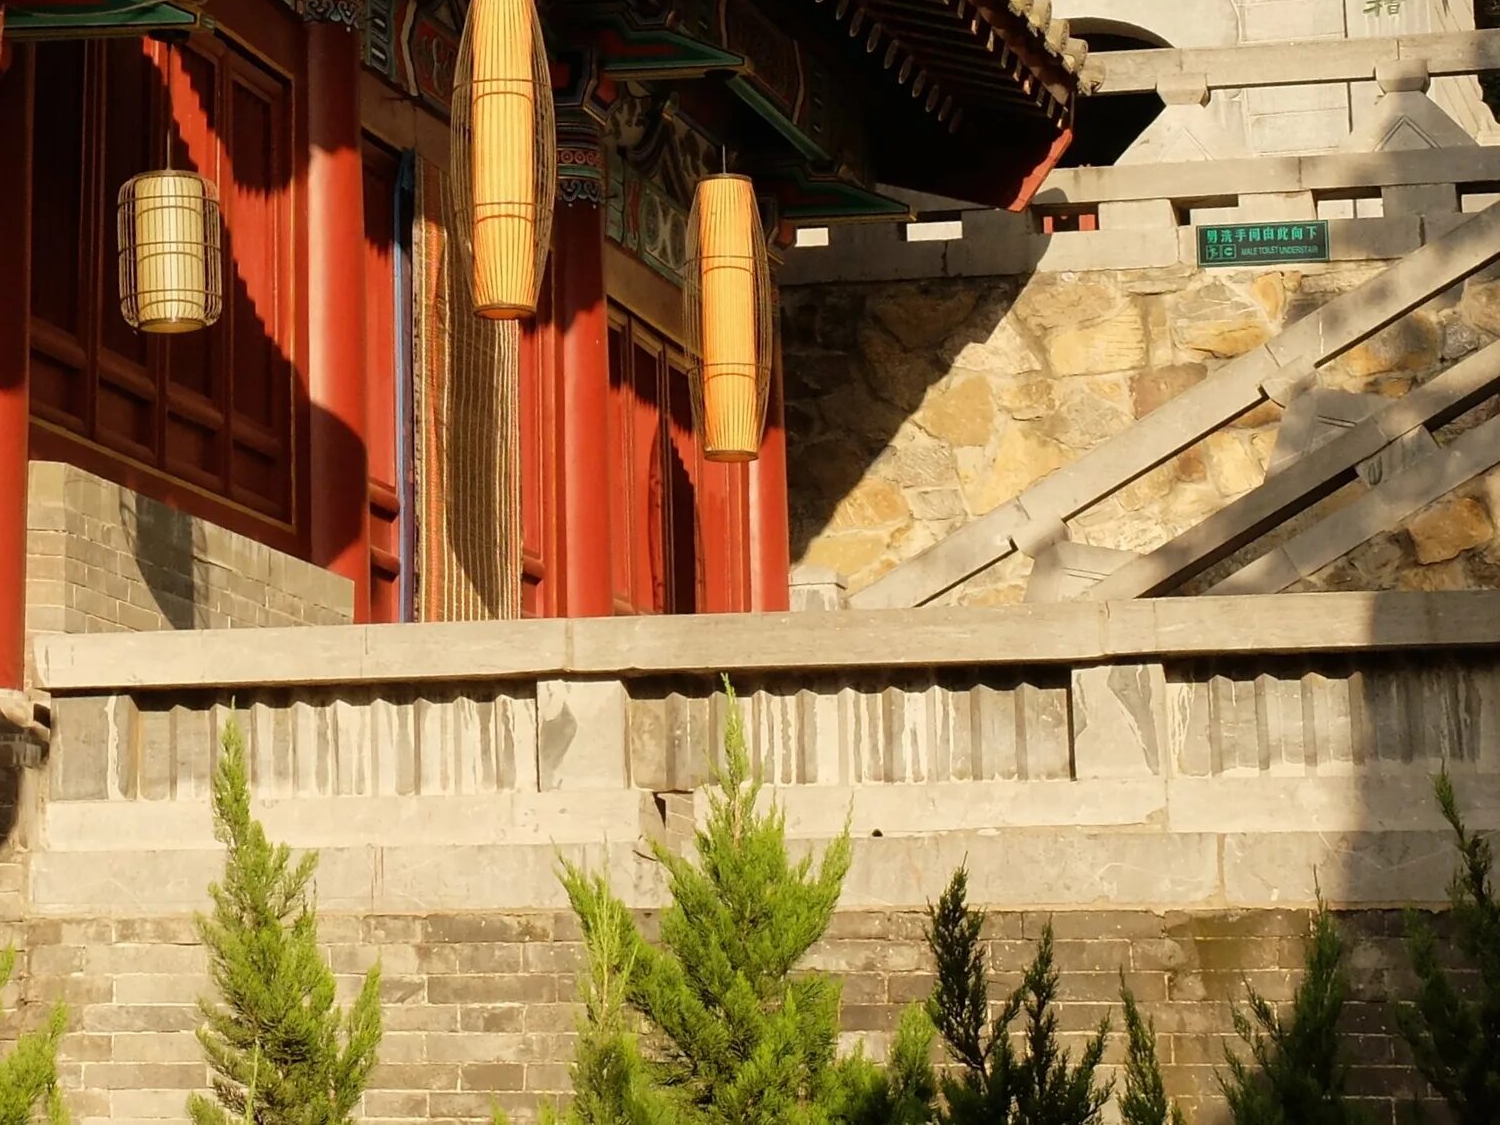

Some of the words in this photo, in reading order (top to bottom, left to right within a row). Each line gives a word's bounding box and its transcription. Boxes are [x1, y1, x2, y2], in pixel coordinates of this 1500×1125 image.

[1206, 225, 1317, 243] 男洗手间由此向下
[1241, 247, 1258, 256] MALE
[1258, 246, 1278, 256] TOILET
